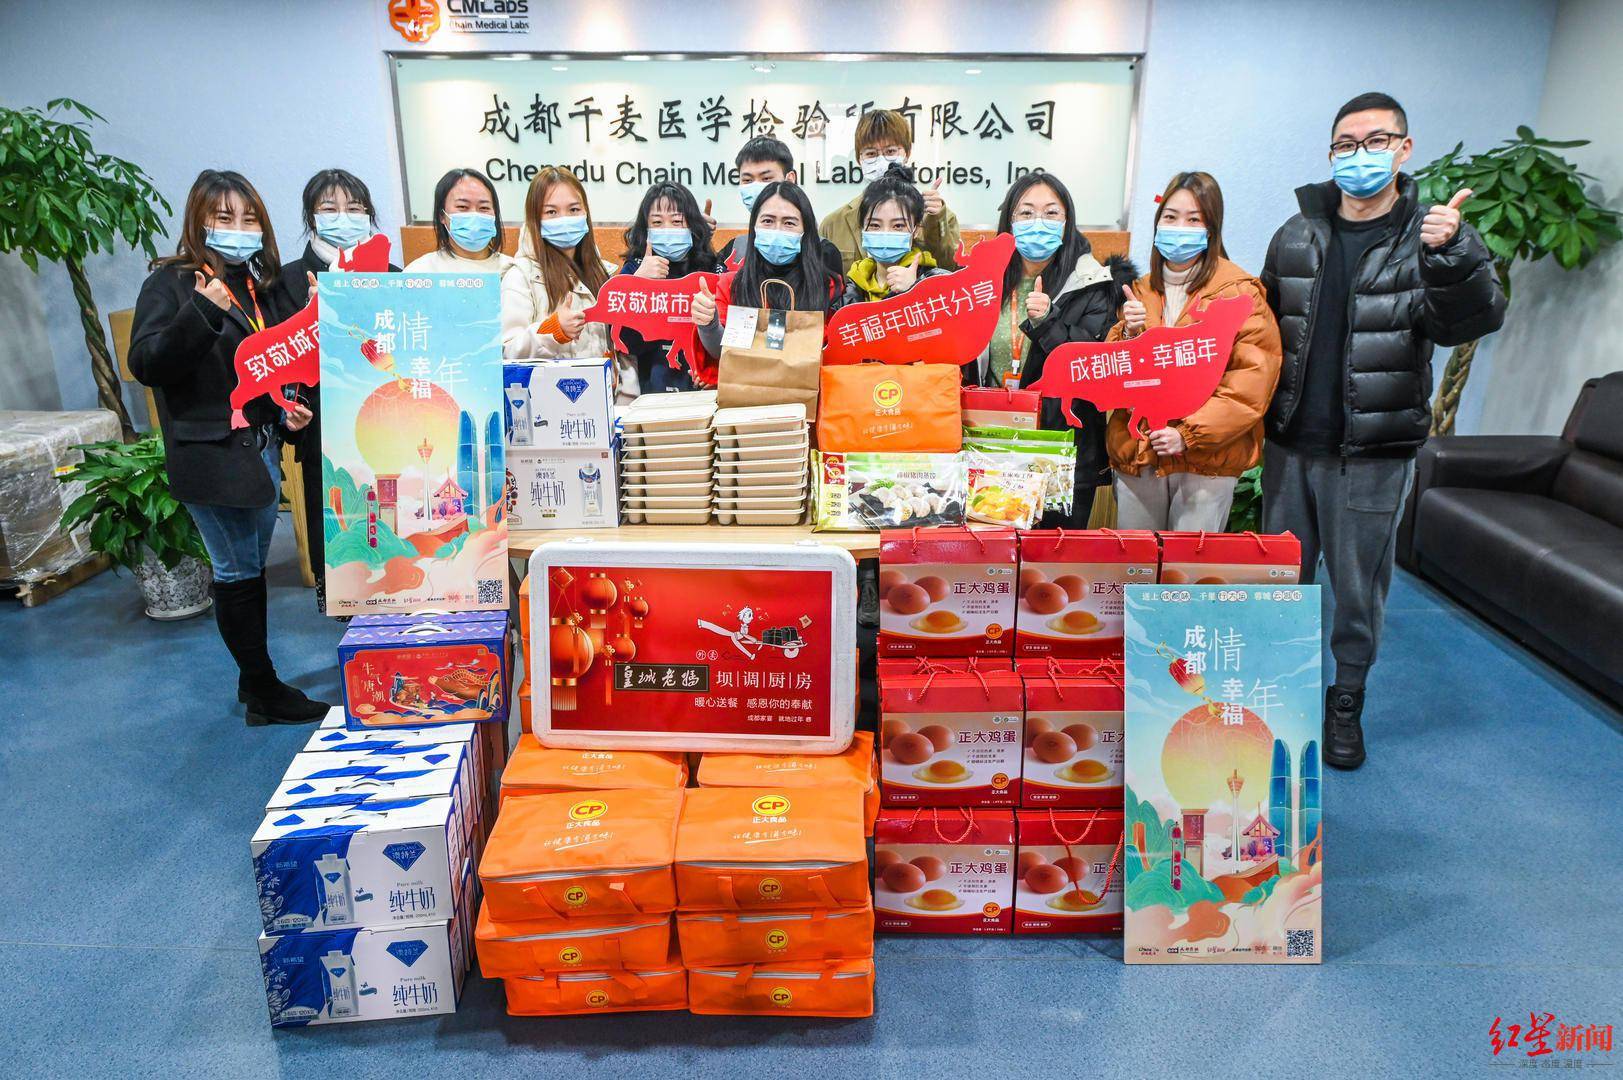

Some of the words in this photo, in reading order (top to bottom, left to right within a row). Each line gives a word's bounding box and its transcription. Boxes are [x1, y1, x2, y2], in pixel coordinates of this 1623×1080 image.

[475, 20, 507, 29] Medical
[510, 20, 529, 29] Labs
[486, 158, 604, 182] Chedu
[615, 161, 691, 184] Chain
[816, 160, 990, 188] Labtories,
[607, 290, 701, 315] 致敬城市
[838, 280, 997, 347] 幸福年味共分享
[878, 389, 899, 400] CP
[560, 418, 596, 440] 纯牛奶
[530, 480, 566, 507] 纯牛奶
[954, 582, 1010, 594] 正大鸡蛋
[988, 627, 999, 635] CP
[623, 665, 699, 689] 皇城老妈
[694, 697, 738, 708] 暖心送餐
[747, 698, 812, 709] 感恩你的奉献
[959, 731, 1016, 743] 正大鸡蛋
[995, 777, 1007, 785] CP
[575, 805, 602, 815] CP
[758, 801, 784, 810] CP
[566, 820, 601, 830] 正大食品
[752, 816, 787, 824] 正大食品
[950, 862, 1007, 874] 正大鸡蛋
[763, 884, 779, 893] CP
[389, 887, 436, 913] 纯牛奶
[568, 891, 583, 901] CP
[769, 935, 784, 943] CP
[562, 952, 578, 961] CP
[393, 982, 438, 1007] 纯牛奶
